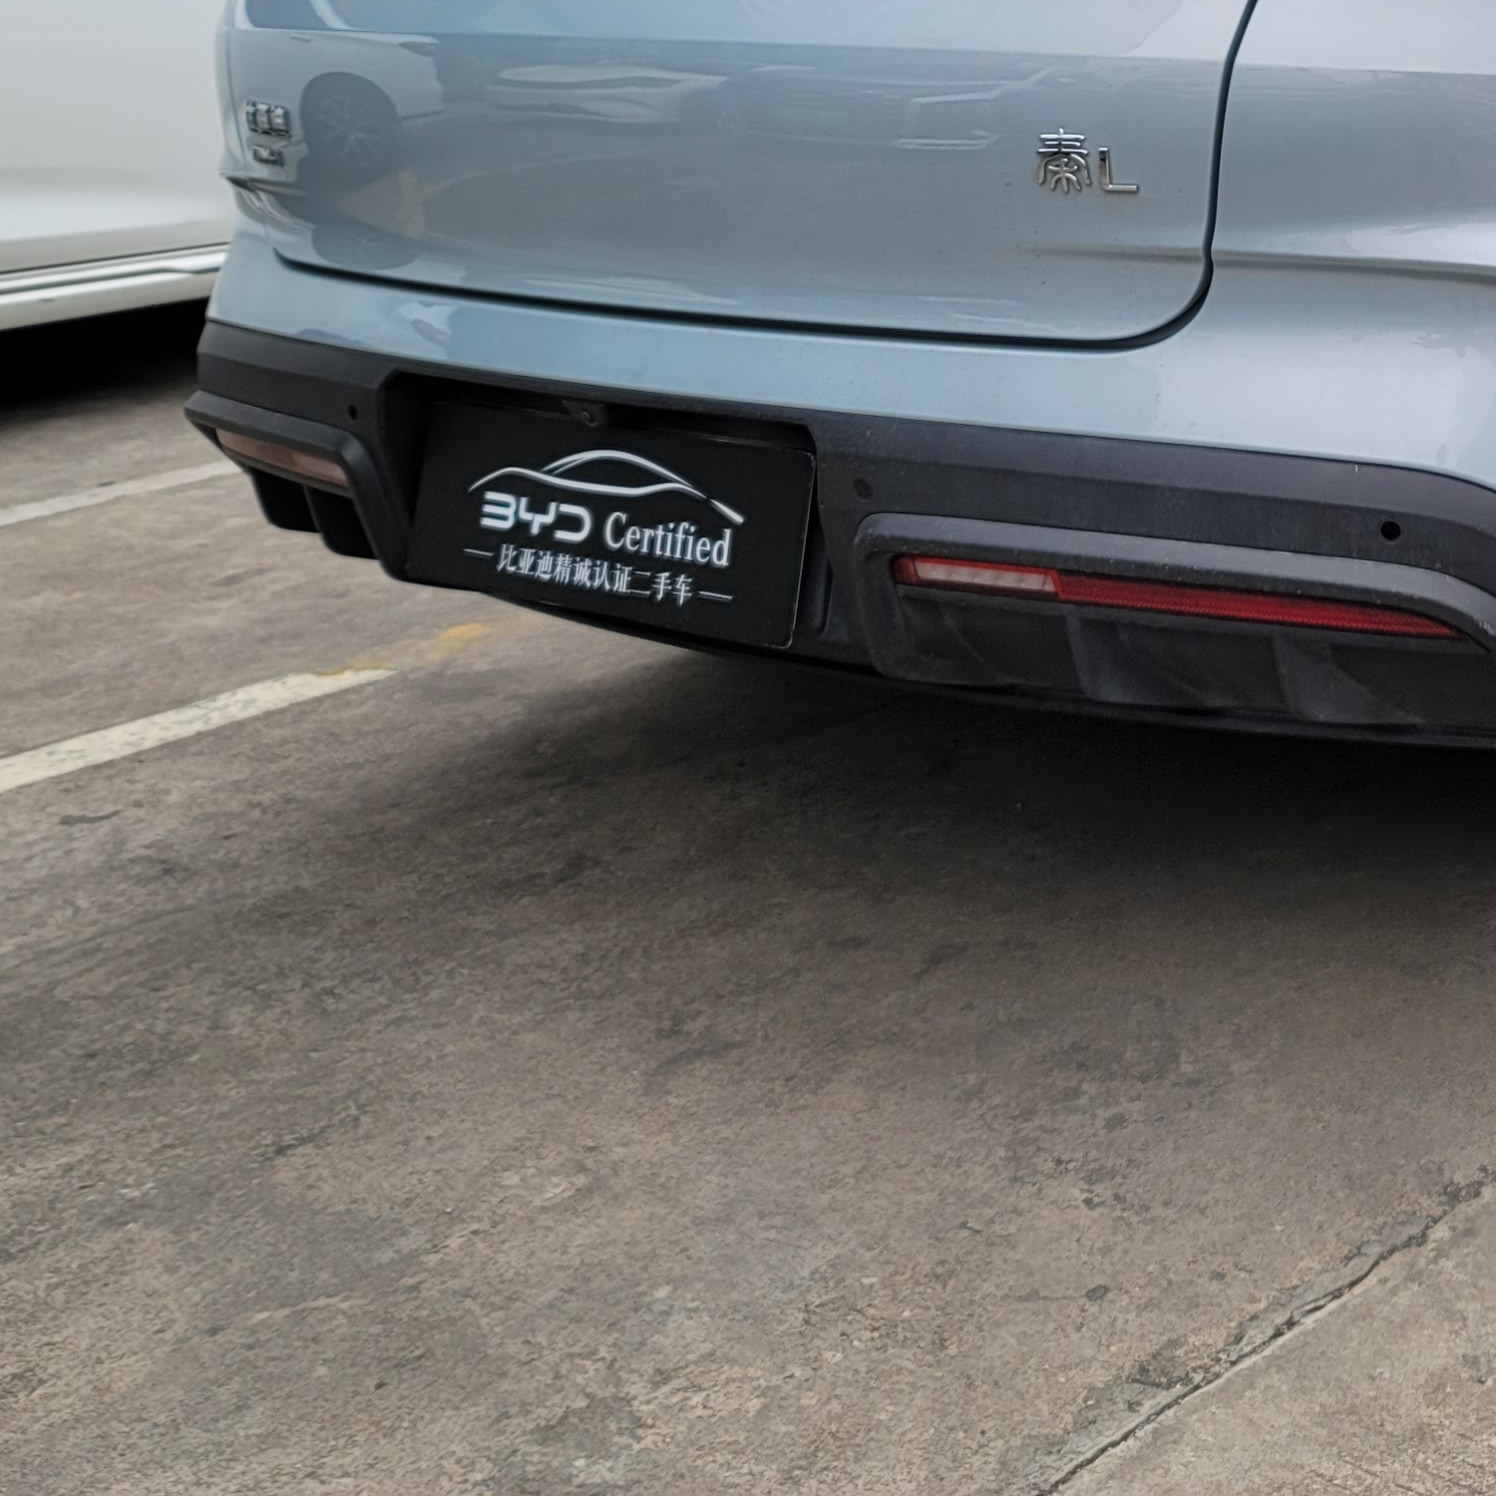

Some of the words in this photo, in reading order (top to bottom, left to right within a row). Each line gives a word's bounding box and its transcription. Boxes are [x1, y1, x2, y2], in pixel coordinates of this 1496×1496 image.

[480, 490, 594, 544] BYD
[604, 511, 733, 567] Certified
[496, 544, 693, 607] 比亚迪精诚认证二手车
